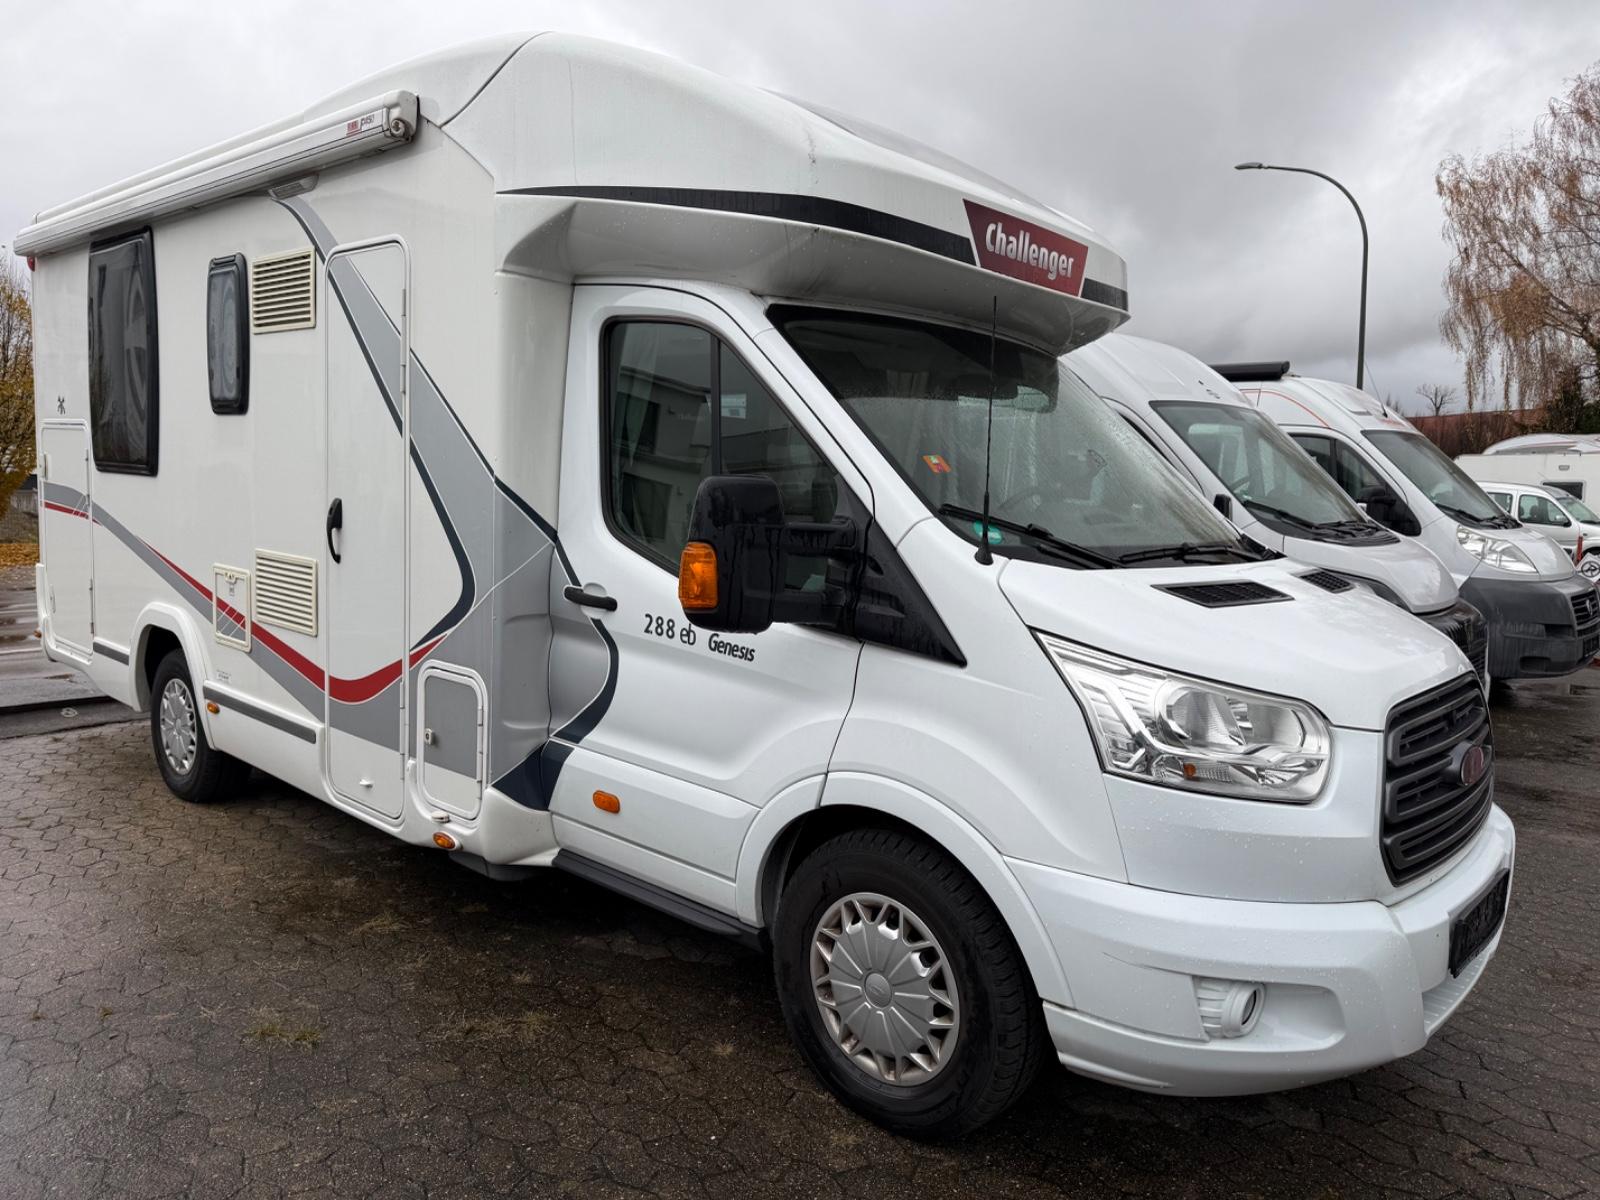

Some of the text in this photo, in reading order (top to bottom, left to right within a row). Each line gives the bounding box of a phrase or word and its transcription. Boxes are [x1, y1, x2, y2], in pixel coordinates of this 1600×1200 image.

[985, 222, 1075, 281] Challenger
[643, 613, 756, 662] 288 eb Genesis
